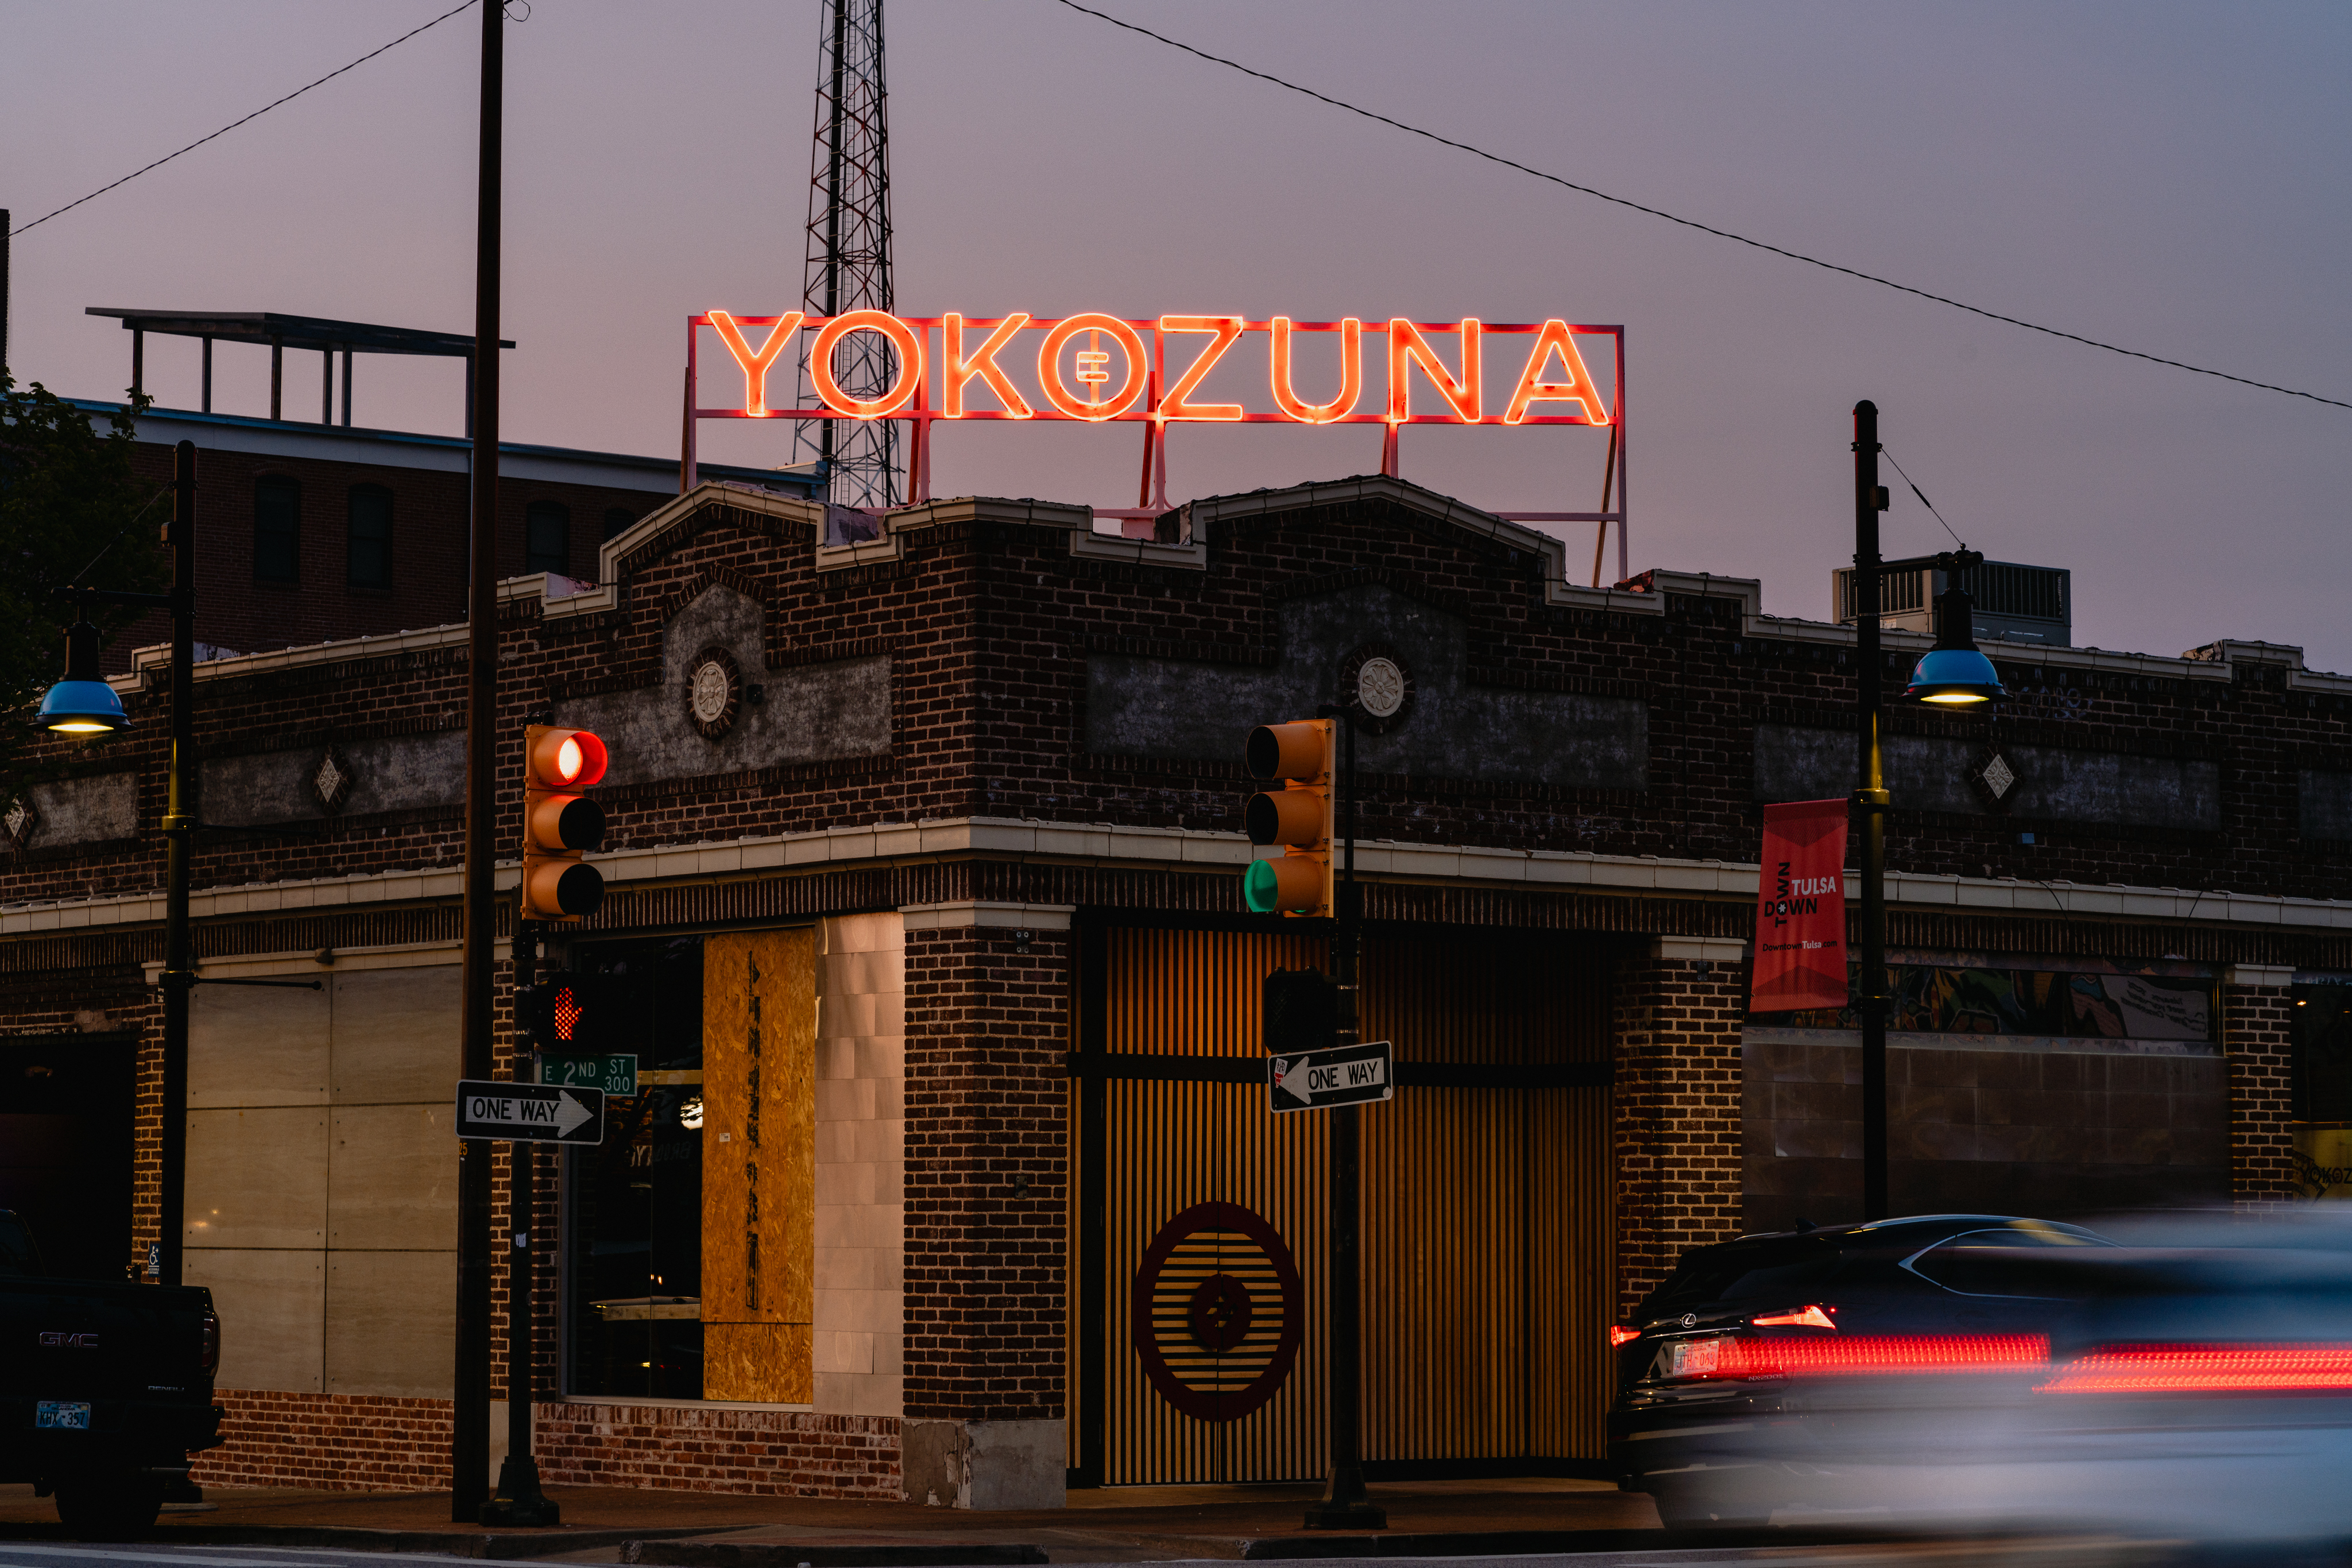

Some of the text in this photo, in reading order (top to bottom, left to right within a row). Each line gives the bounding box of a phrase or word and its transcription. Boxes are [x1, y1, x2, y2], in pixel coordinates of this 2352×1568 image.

[704, 309, 1611, 425] YOKOZUNA
[1792, 876, 1836, 896] TULSA
[1764, 897, 1817, 917] DOWN
[1762, 939, 1838, 952] DowntownTulsa.com
[546, 1066, 552, 1081] E
[610, 1059, 625, 1074] ST
[1308, 1067, 1339, 1090] ONE
[1348, 1061, 1378, 1085] WAY
[605, 1077, 630, 1091] 300
[473, 1098, 560, 1122] ONE WAY
[39, 1331, 99, 1348] GMC
